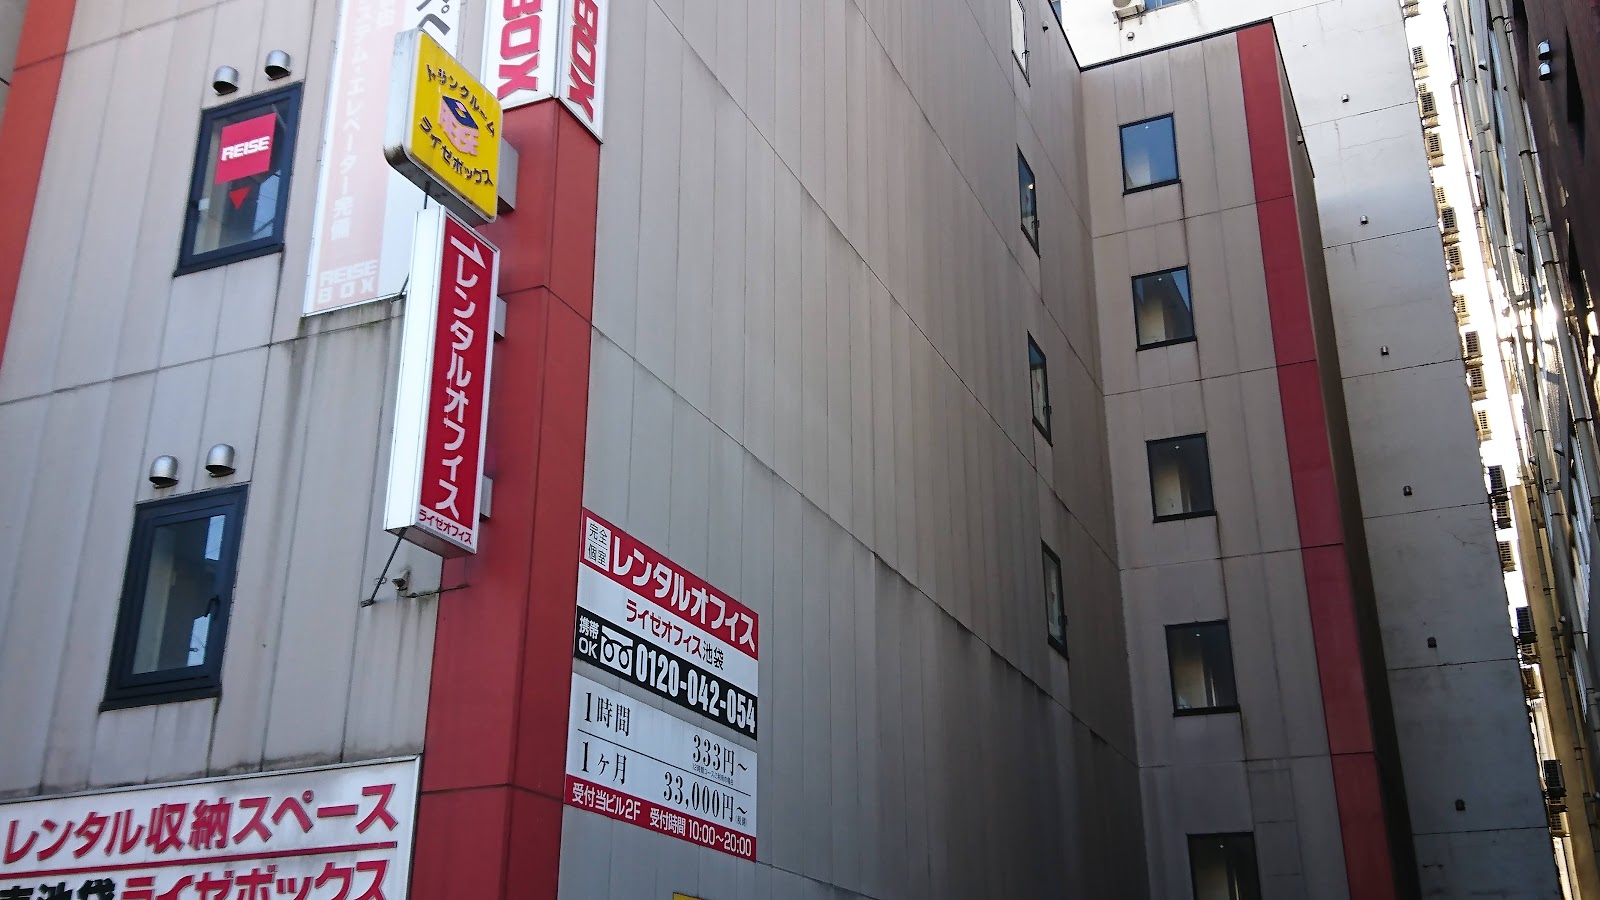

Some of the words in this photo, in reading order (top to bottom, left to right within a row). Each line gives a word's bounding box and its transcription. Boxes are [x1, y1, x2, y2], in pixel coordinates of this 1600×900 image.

[567, 0, 599, 123] BOX
[426, 64, 495, 137] トランクルーム
[220, 136, 271, 162] REISE
[419, 116, 494, 186] ライゼボックス
[318, 276, 375, 304] BOX
[320, 259, 378, 288] REISE
[435, 254, 479, 520] レンタルオフィス
[419, 509, 472, 545] ライゼオフィス
[589, 523, 608, 547] 完全
[587, 543, 607, 567] 個室
[613, 536, 756, 652] レンタルオフィス
[578, 637, 599, 660] OK
[579, 615, 600, 641] 携帯
[626, 598, 725, 670] ライゼオフィス池袋
[635, 643, 756, 734] 0120-042-054
[584, 692, 631, 737] 1時間
[4, 783, 398, 864] レンタル収納スペース
[572, 782, 642, 821] 受付当ビル2F
[650, 807, 686, 837] 受付時間
